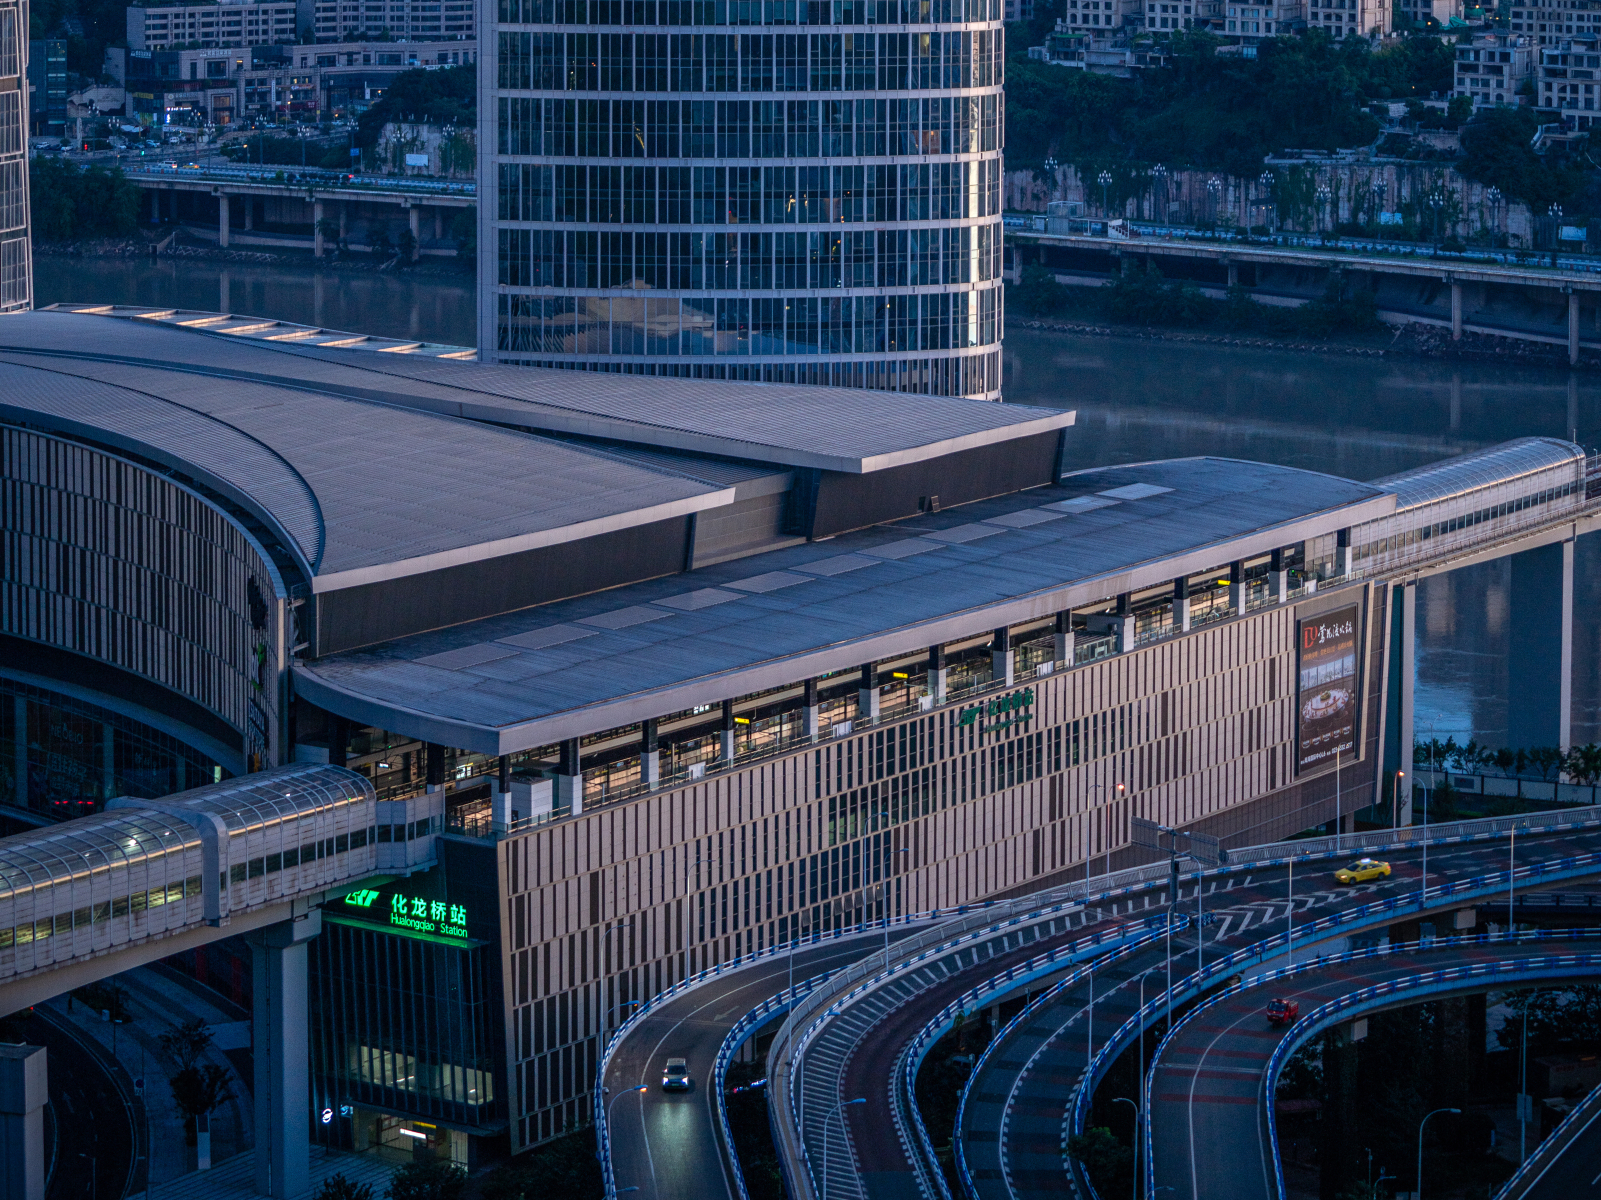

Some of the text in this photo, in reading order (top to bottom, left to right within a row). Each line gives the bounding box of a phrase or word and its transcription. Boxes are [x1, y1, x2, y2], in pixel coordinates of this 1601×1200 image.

[391, 893, 467, 925] 化龙桥站
[390, 913, 468, 938] Hualongqiao Station
